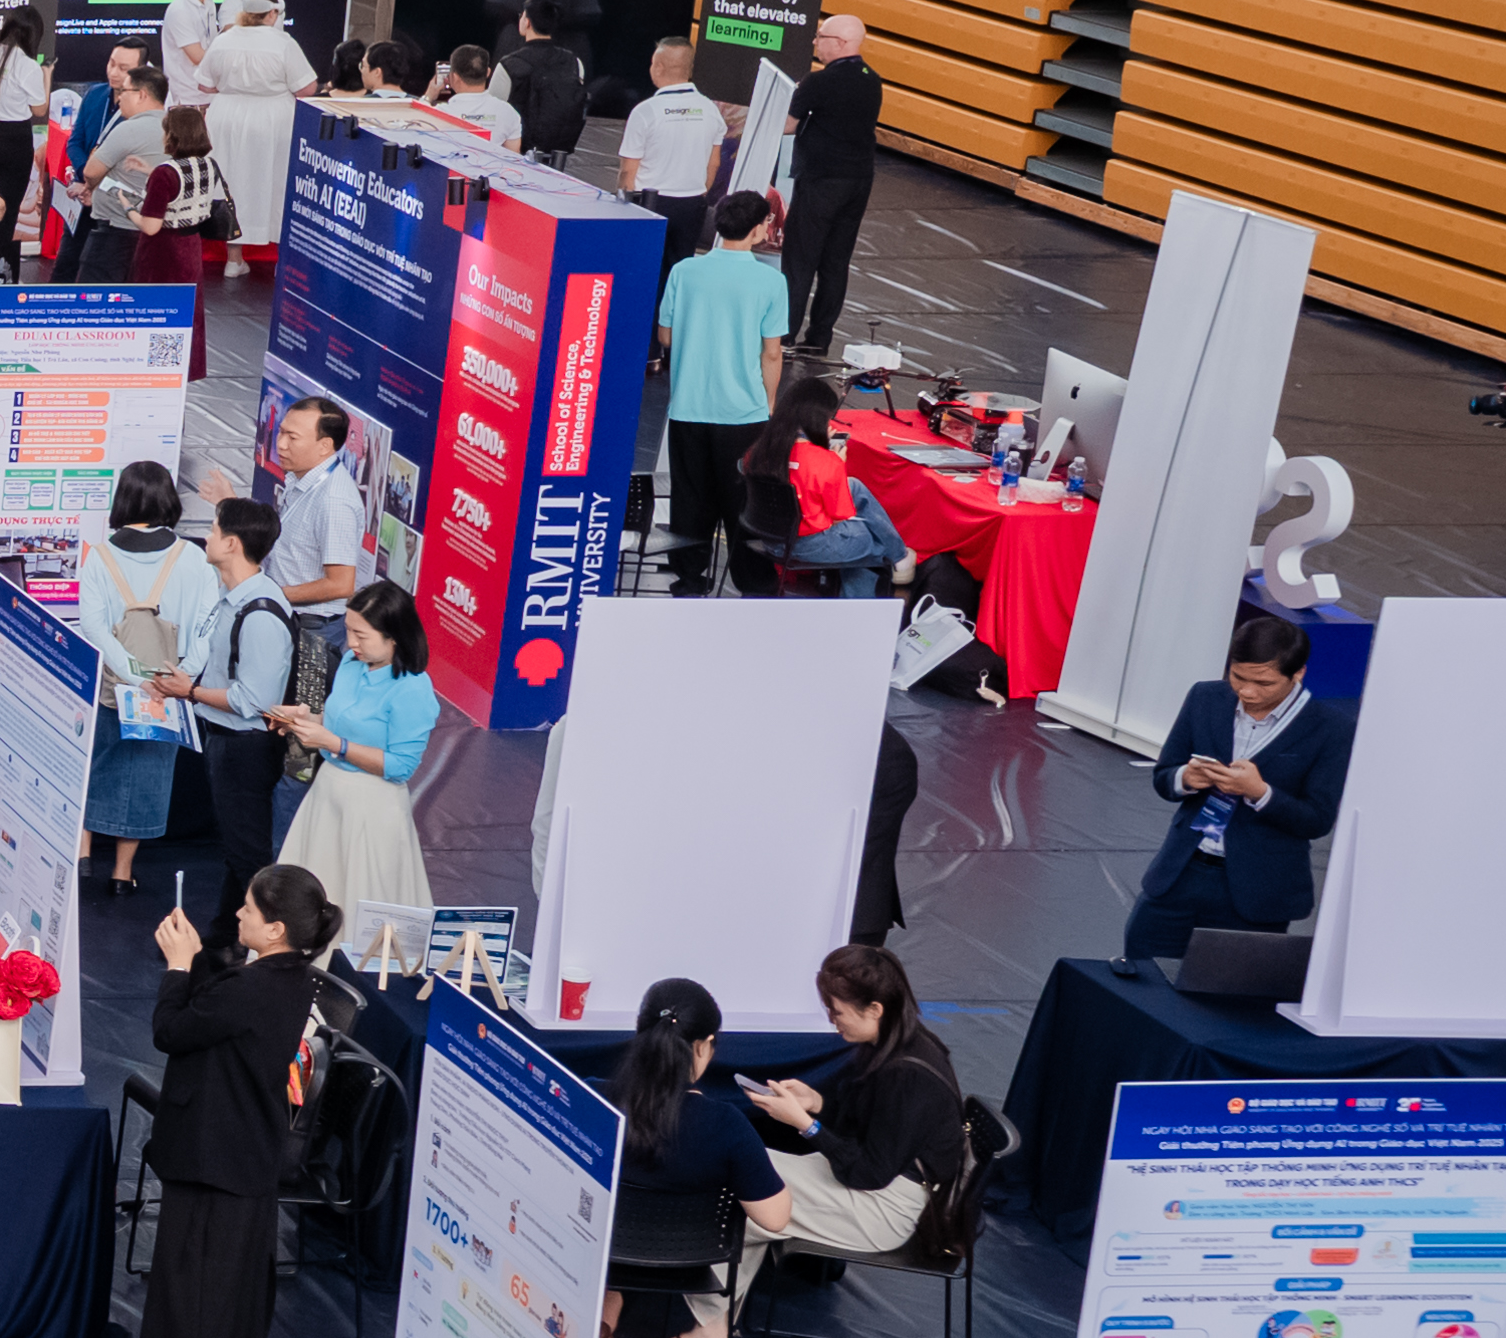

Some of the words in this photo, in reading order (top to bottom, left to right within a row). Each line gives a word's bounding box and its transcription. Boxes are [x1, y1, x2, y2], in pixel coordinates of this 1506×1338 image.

[711, 19, 773, 45] learning.
[747, 3, 806, 25] elevates
[295, 174, 318, 202] with
[319, 183, 333, 210] AI
[334, 189, 367, 229] (EEAI)
[298, 137, 366, 196] Empowering
[367, 171, 424, 221] Educators
[468, 263, 490, 292] Our
[491, 274, 532, 315] Impacts
[14, 331, 53, 341] EDUAI
[56, 331, 136, 341] CLASSROOM
[580, 279, 607, 367] Technology
[461, 345, 518, 397] 350,000+
[559, 340, 582, 401] Science,
[578, 367, 591, 379] &
[558, 403, 570, 419] of
[566, 382, 593, 471] Engineering
[457, 412, 506, 461] 61,000+
[550, 422, 569, 471] School
[31, 516, 62, 527] THỰC
[66, 514, 81, 525] TẾ
[452, 488, 492, 532] 7,750+
[521, 484, 585, 631] RMIT
[426, 1197, 468, 1248] 1700+
[510, 1274, 530, 1307] 65
